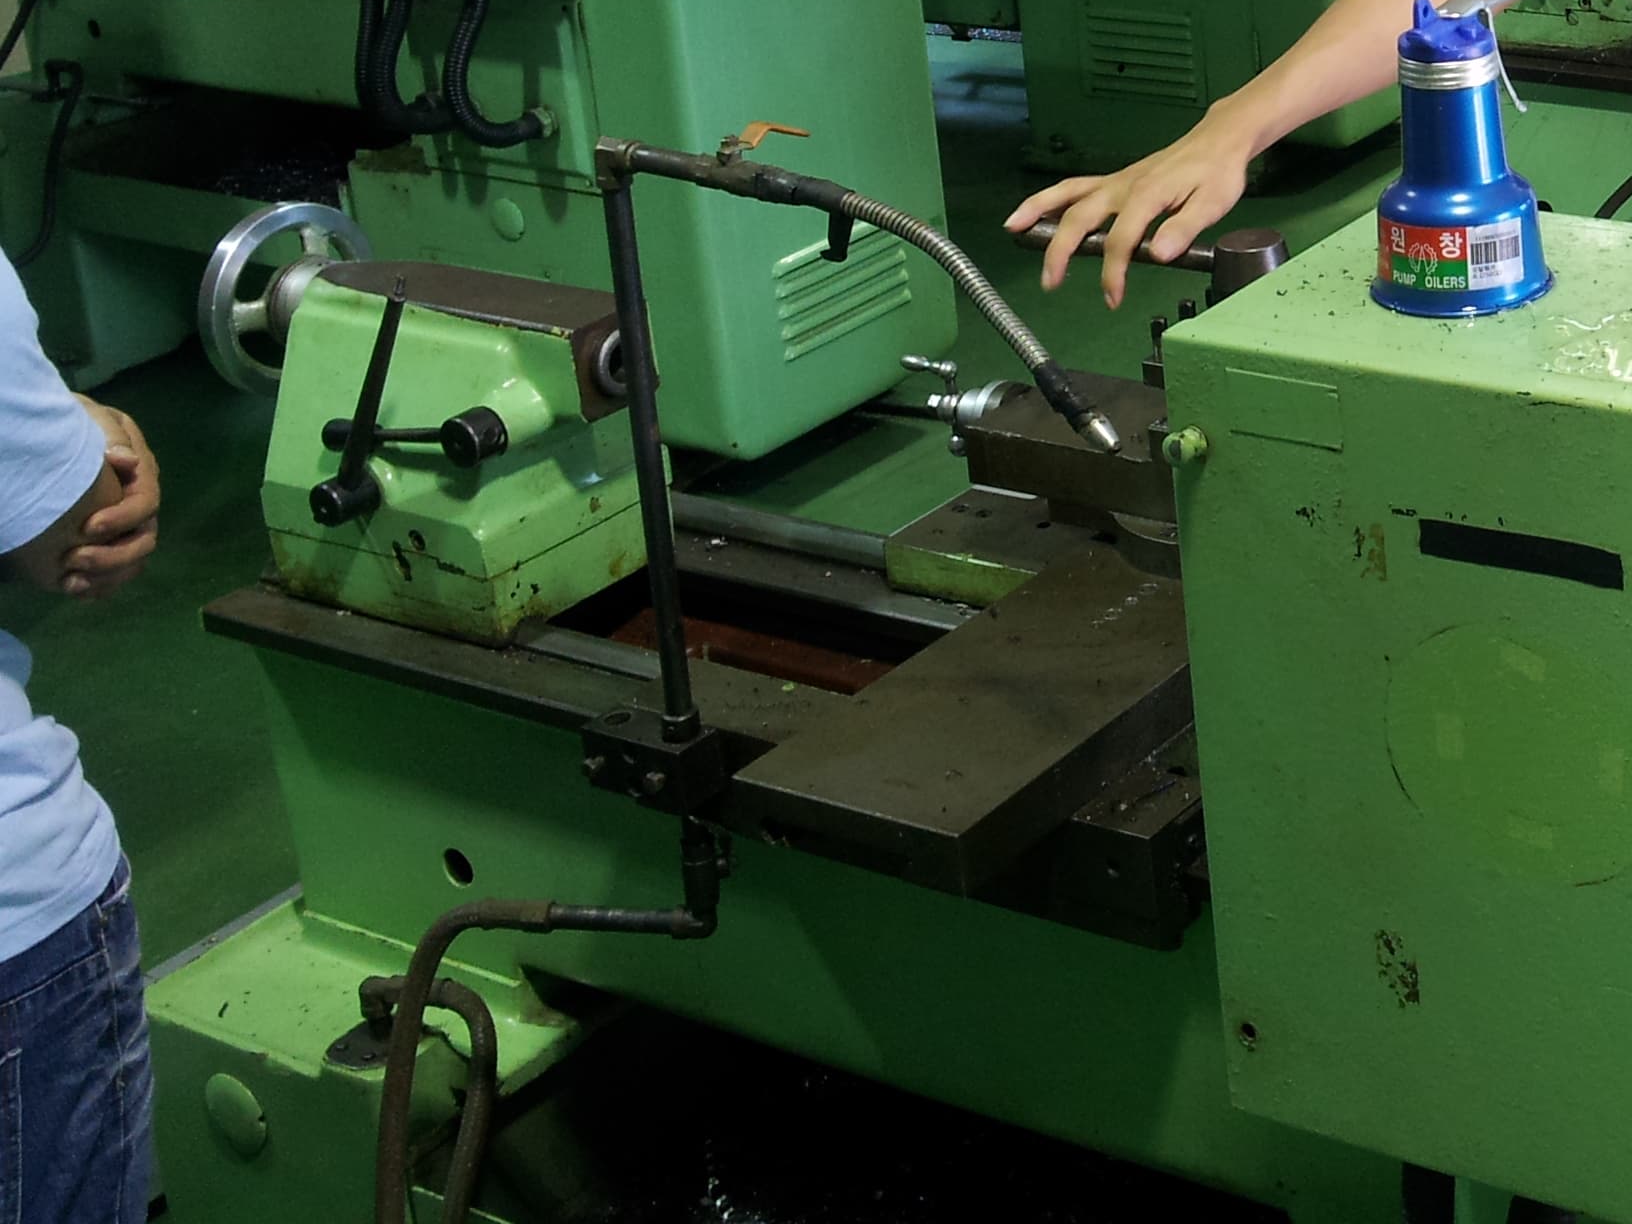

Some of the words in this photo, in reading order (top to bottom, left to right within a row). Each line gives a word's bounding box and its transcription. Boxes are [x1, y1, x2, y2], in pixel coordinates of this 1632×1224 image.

[1390, 226, 1405, 254] 원
[1439, 232, 1463, 258] 창
[1392, 270, 1417, 286] PUMP
[1424, 276, 1467, 289] OILERS
